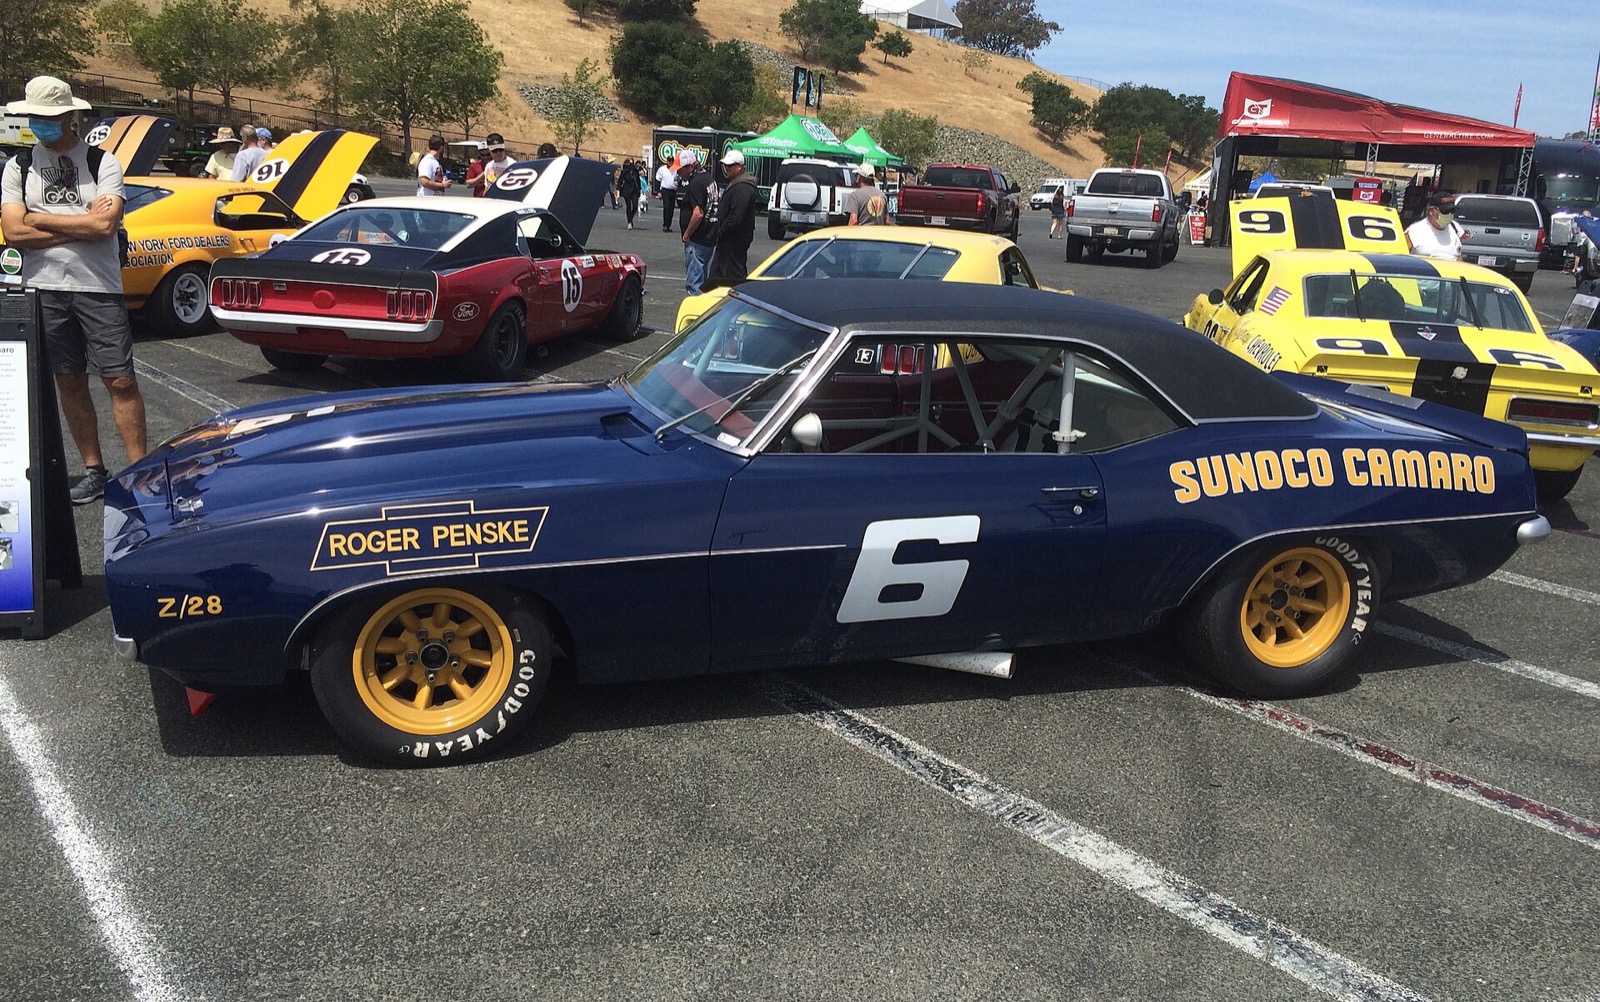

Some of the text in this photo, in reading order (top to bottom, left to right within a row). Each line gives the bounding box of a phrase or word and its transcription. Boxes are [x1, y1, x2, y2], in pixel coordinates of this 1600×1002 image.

[140, 238, 168, 252] YORK
[168, 236, 194, 249] FORD
[194, 235, 231, 248] DEALERS
[125, 253, 174, 268] SOCIATION
[563, 267, 581, 305] 15
[457, 304, 475, 318] Ford
[1169, 448, 1495, 503] SUNOCO CAMARO
[329, 519, 529, 557] ROGER PENSKE
[836, 514, 981, 624] 6
[157, 594, 223, 619] Z/28
